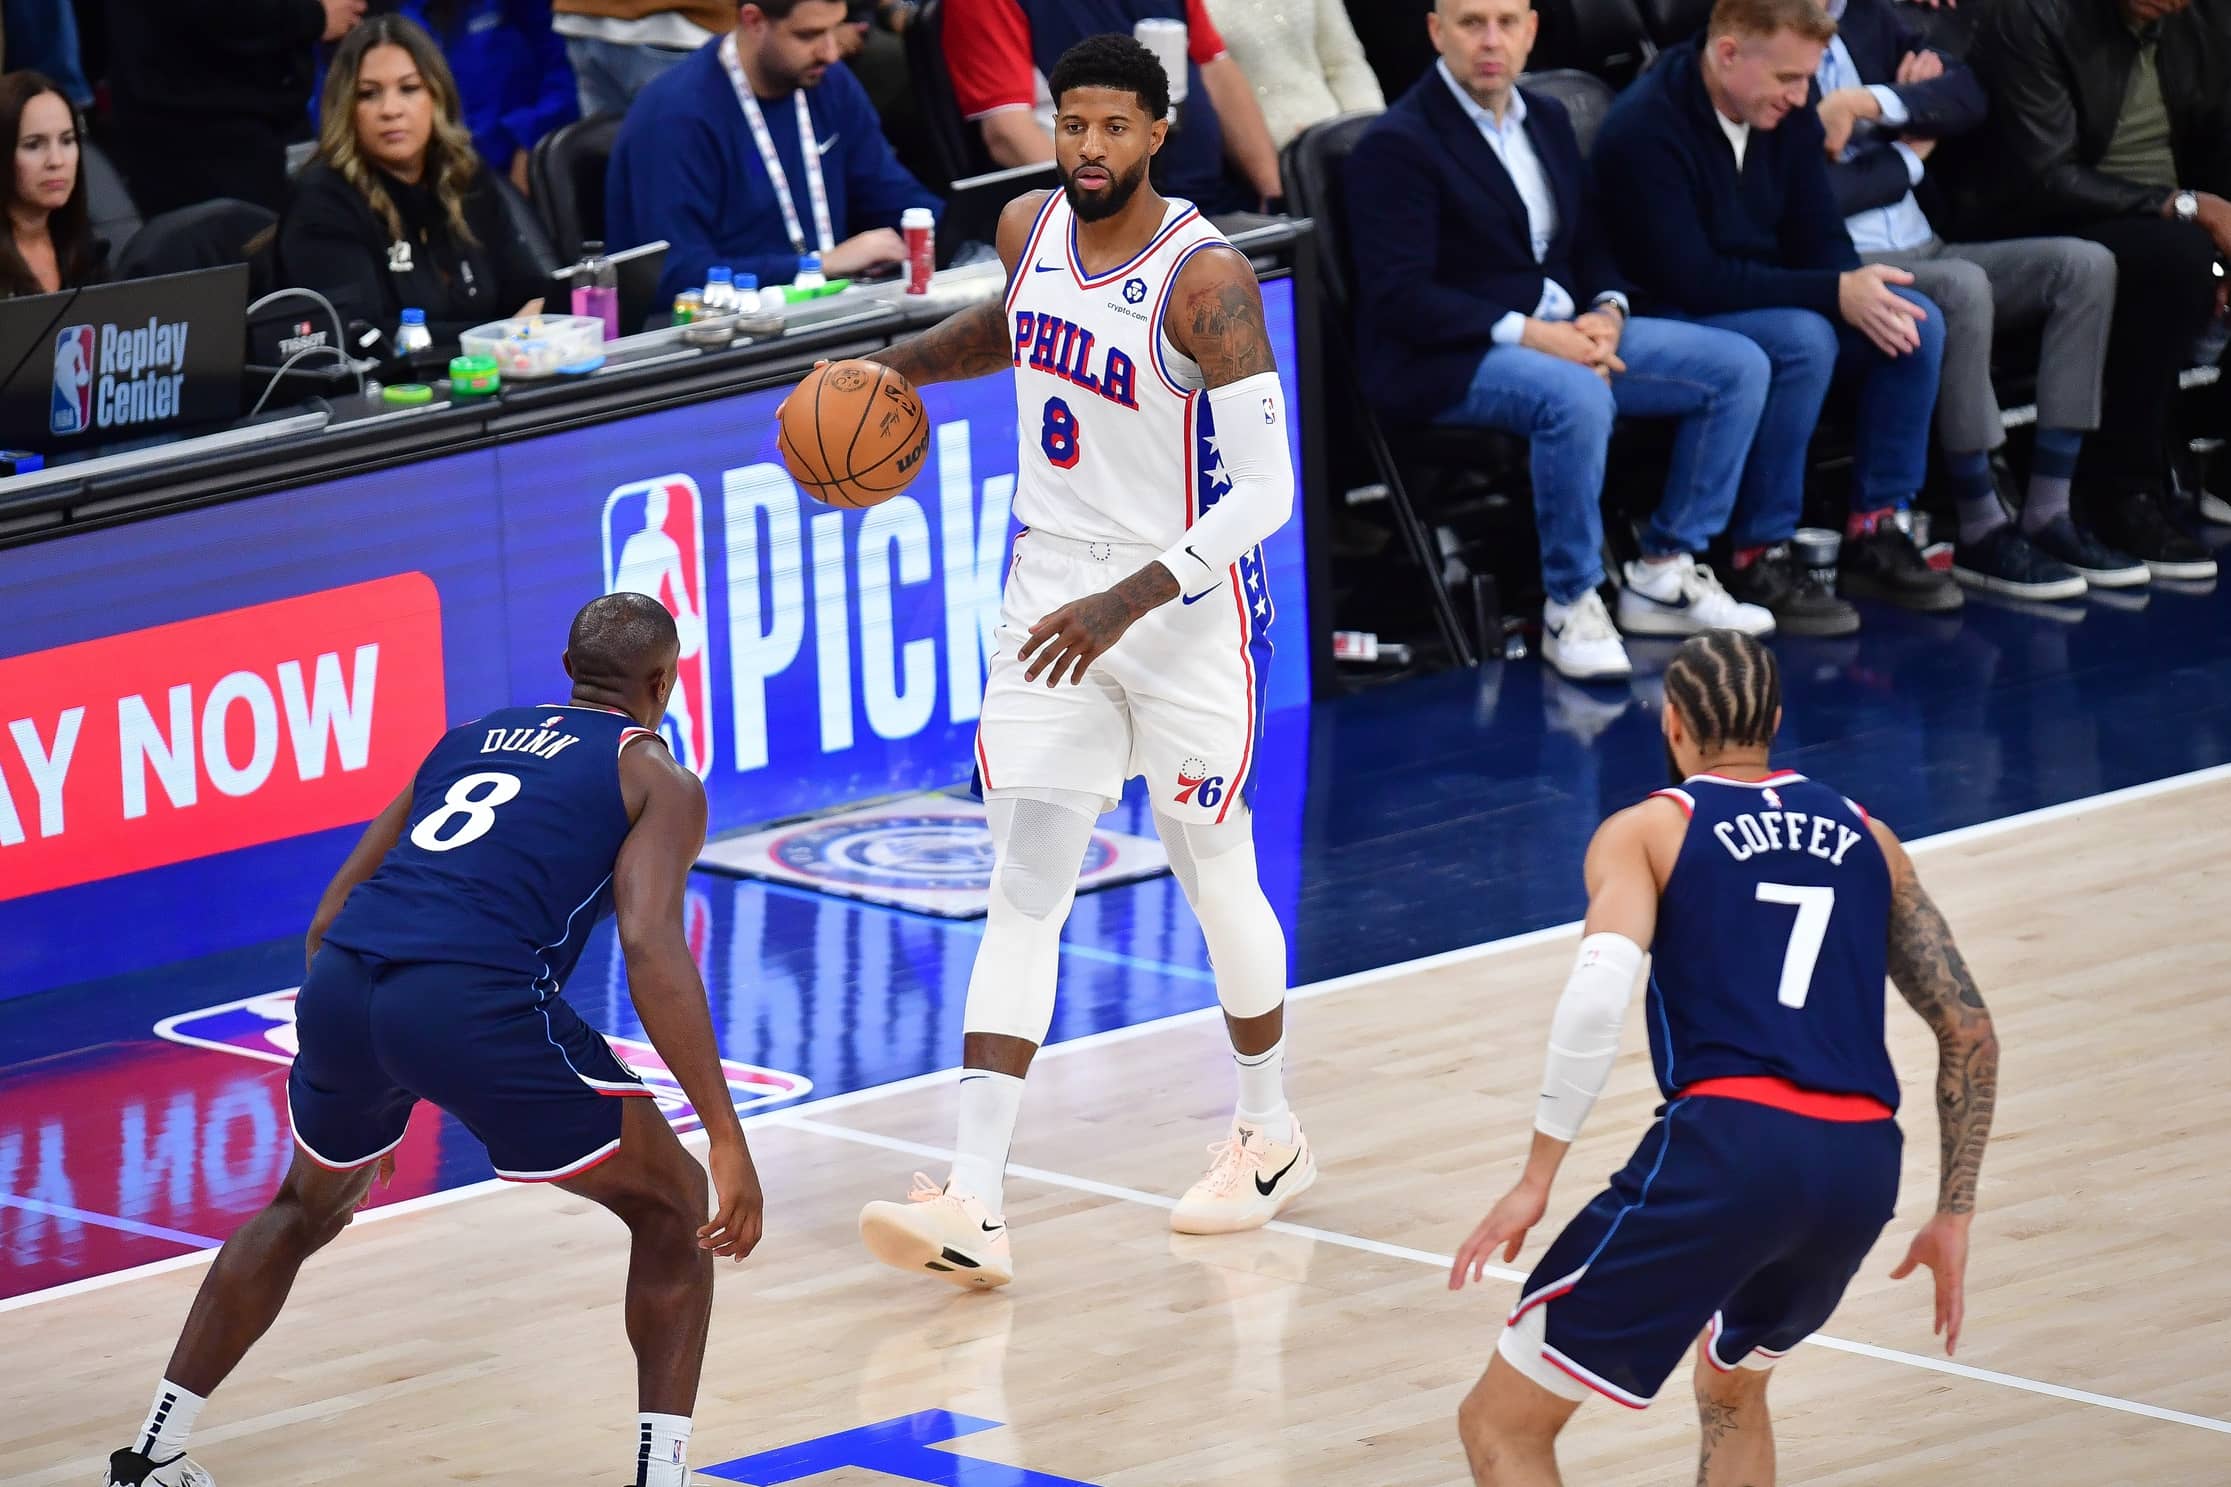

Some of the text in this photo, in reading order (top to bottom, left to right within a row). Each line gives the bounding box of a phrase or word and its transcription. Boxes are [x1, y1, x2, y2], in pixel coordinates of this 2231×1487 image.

[1107, 302, 1148, 322] crypto.com
[100, 316, 188, 379] Replay
[1014, 311, 1139, 412] PHILA
[96, 370, 184, 428] Center
[1041, 396, 1080, 470] 8
[118, 642, 379, 820] NOW
[480, 728, 580, 759] DUNN
[410, 772, 521, 851] 8
[1174, 773, 1224, 808] 76
[1713, 811, 1862, 866] COFFEY
[1755, 882, 1835, 1009] 7
